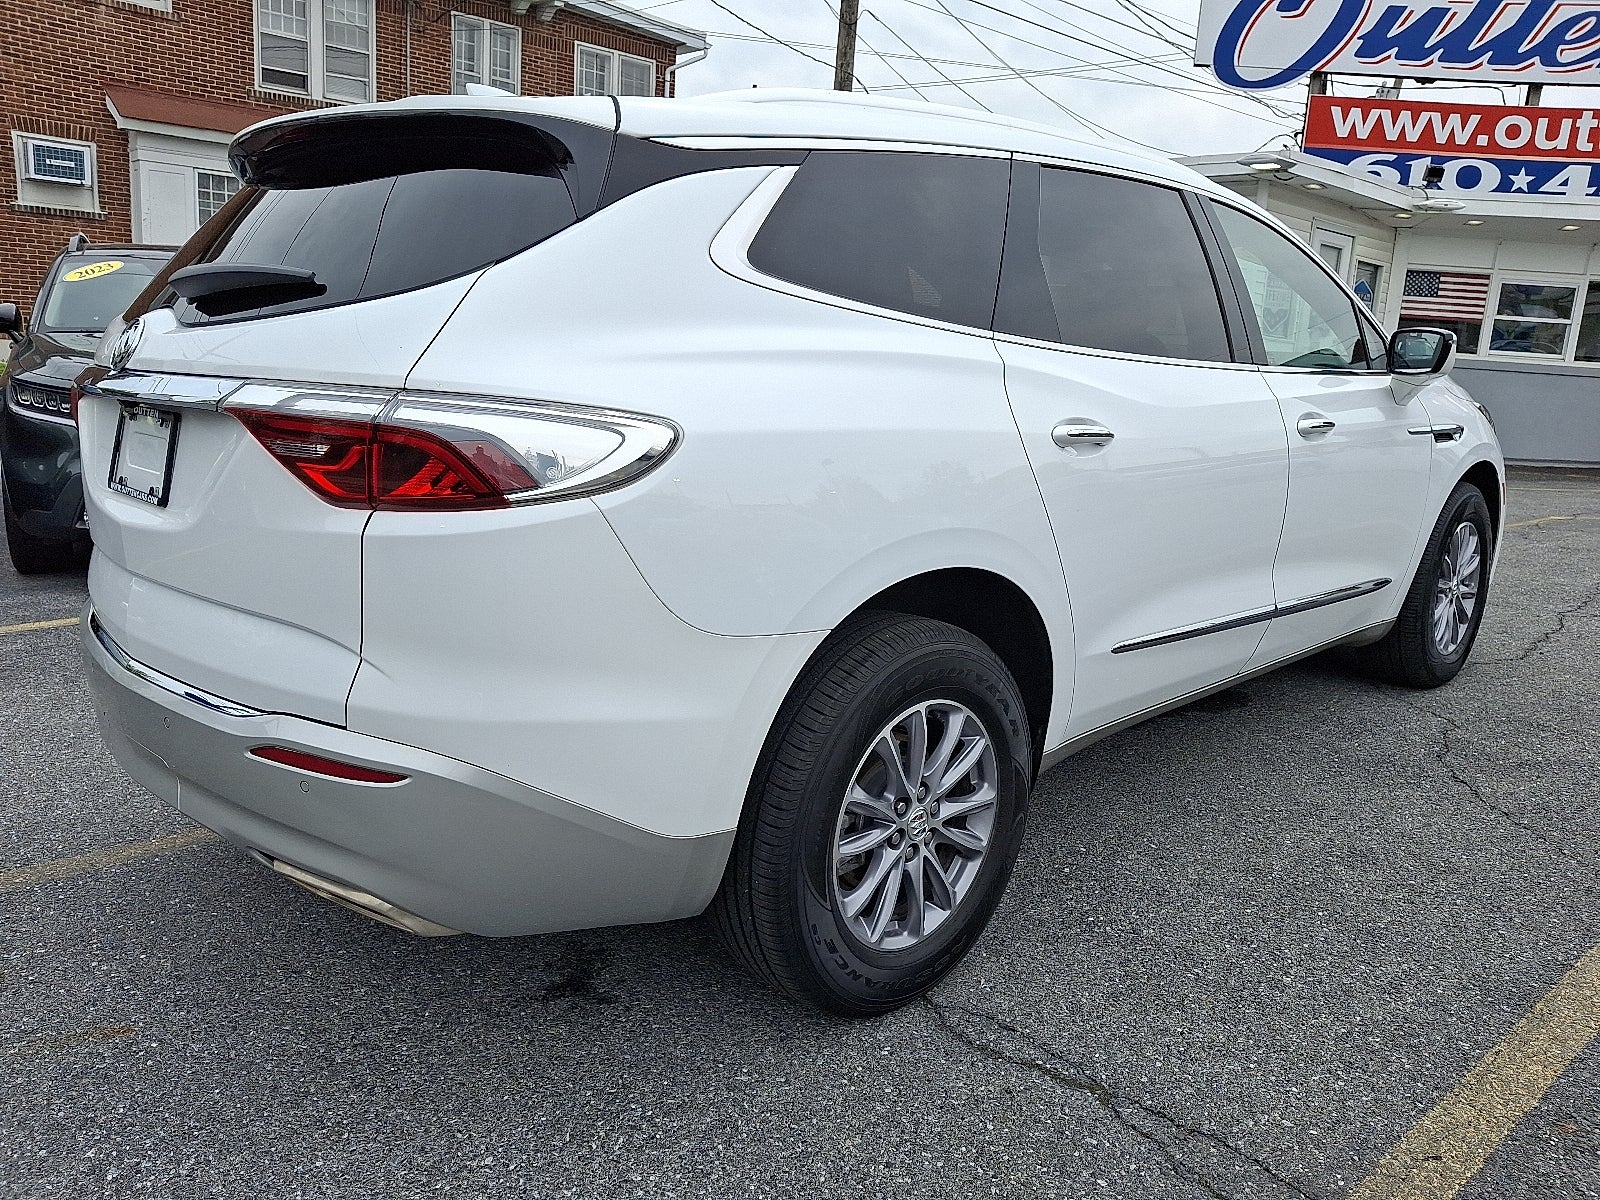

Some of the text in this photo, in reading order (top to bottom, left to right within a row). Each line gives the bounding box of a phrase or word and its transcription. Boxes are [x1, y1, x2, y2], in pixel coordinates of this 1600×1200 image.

[1212, 0, 1600, 89] Outte
[1331, 106, 1600, 151] www.out
[76, 263, 114, 278] 2023
[133, 407, 159, 419] OUTTEN
